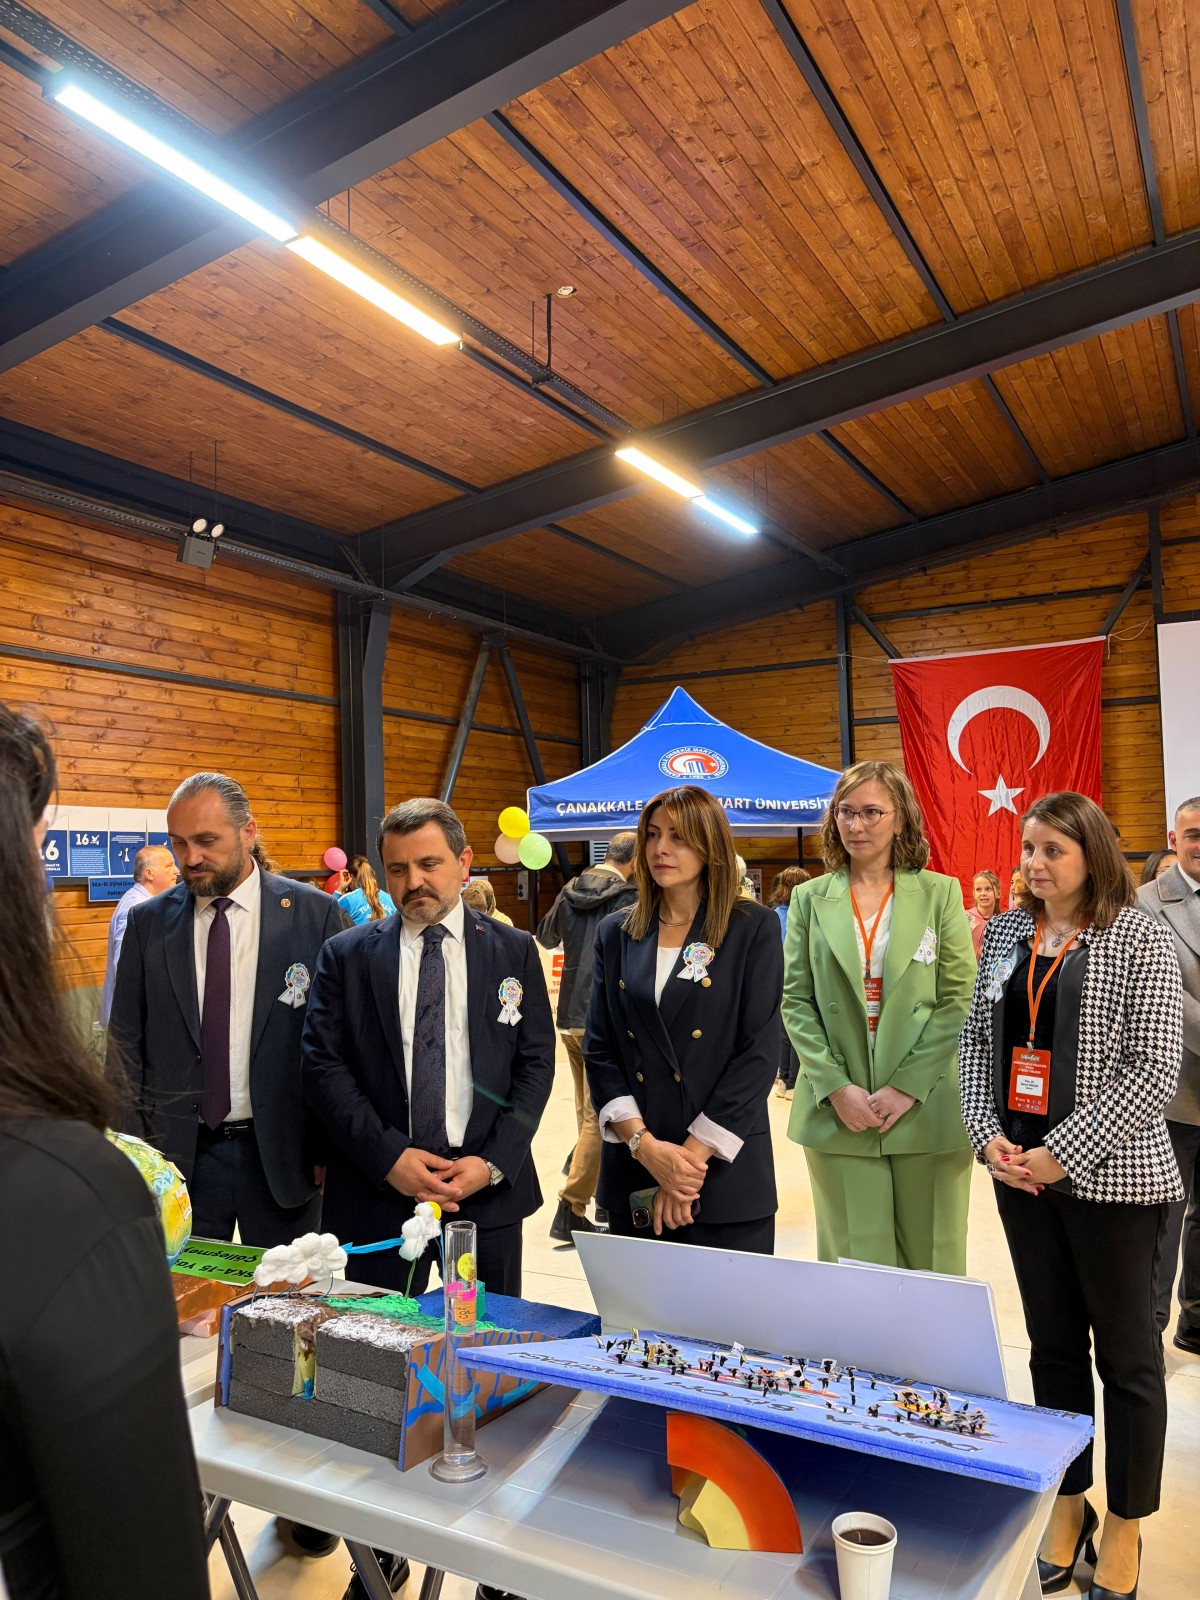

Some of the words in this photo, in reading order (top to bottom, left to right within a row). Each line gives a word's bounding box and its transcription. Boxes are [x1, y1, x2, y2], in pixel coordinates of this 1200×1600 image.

[556, 800, 643, 816] ÇANAKKALE
[76, 833, 90, 846] 16
[199, 1264, 254, 1278] SKA-15
